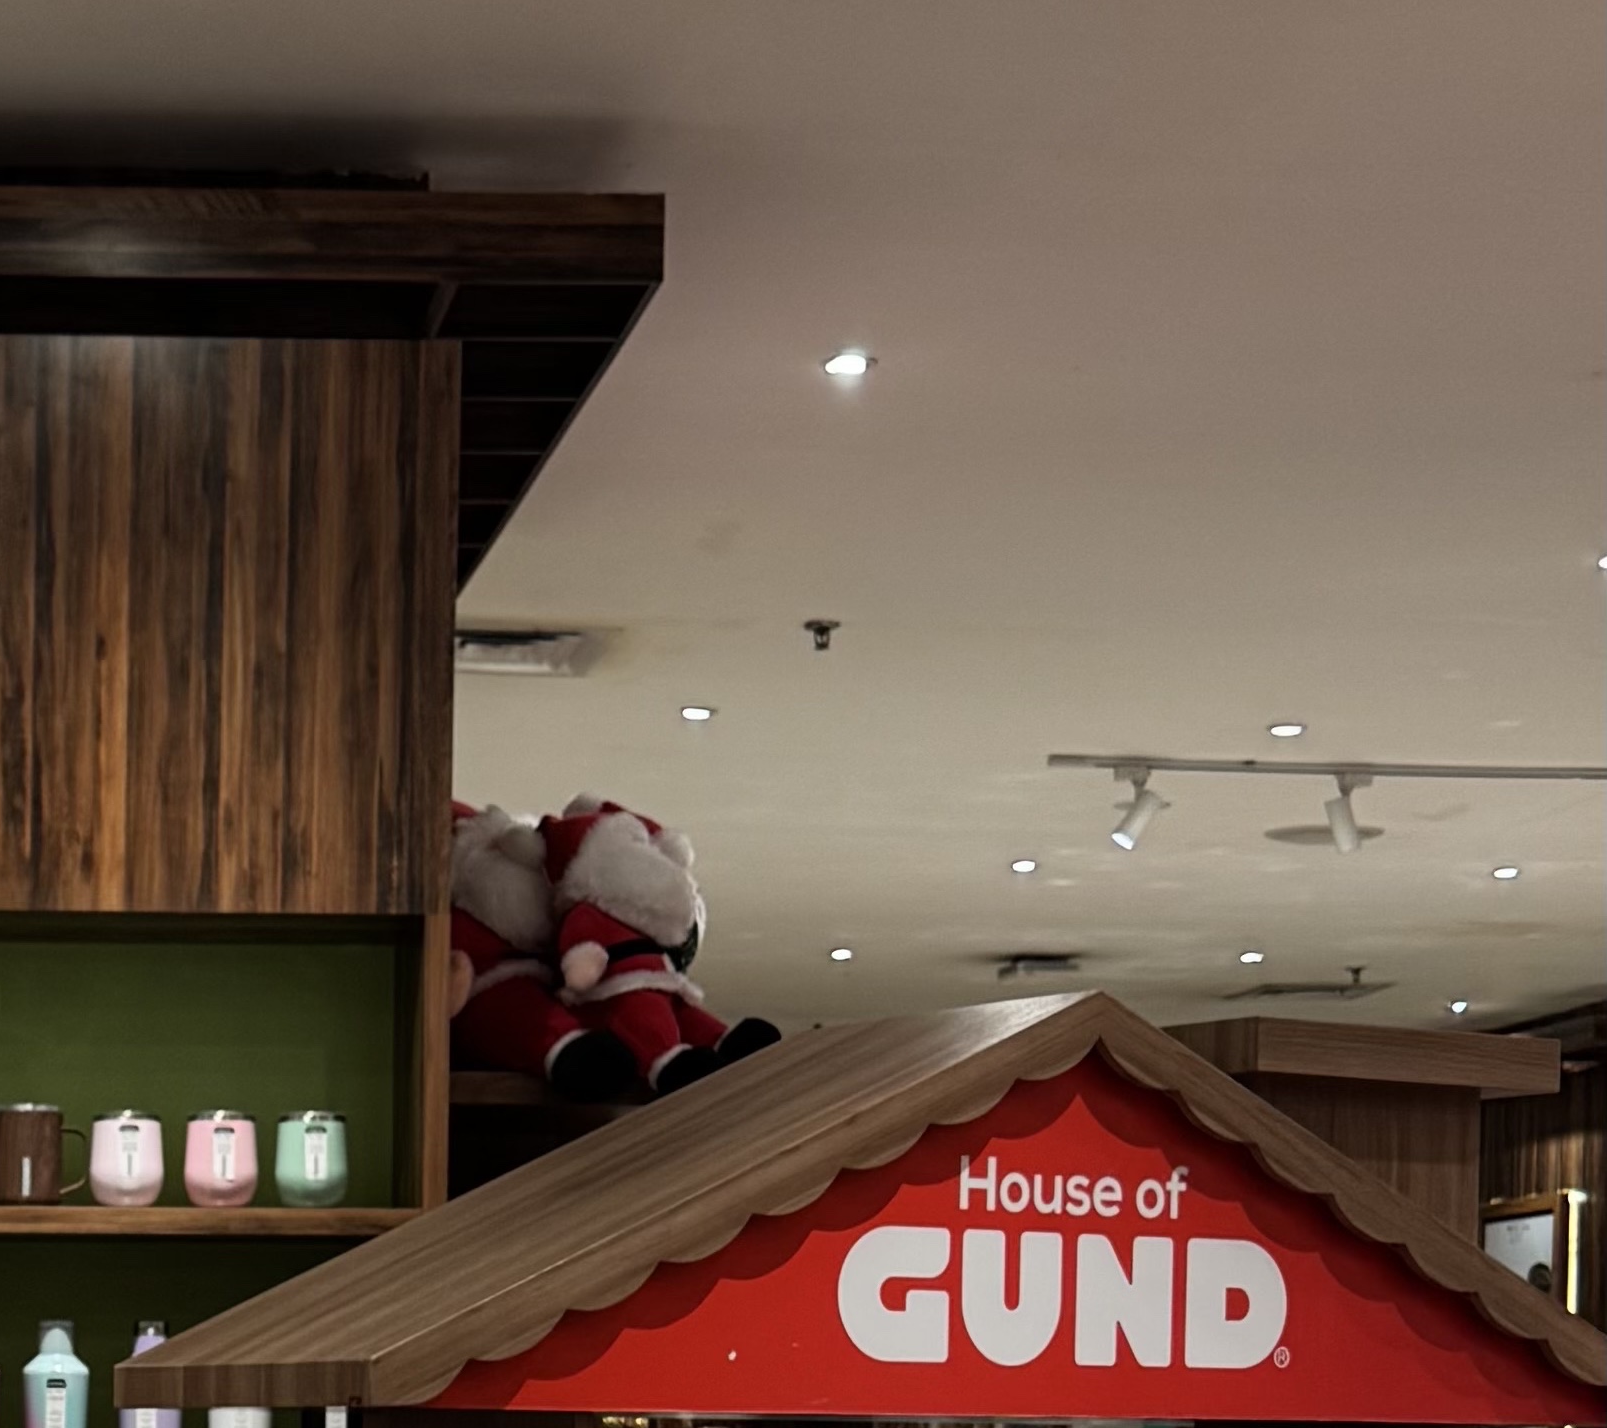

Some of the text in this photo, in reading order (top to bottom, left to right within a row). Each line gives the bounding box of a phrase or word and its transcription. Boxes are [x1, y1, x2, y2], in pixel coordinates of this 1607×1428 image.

[959, 1155, 1188, 1220] House of
[837, 1225, 1288, 1369] GUND
